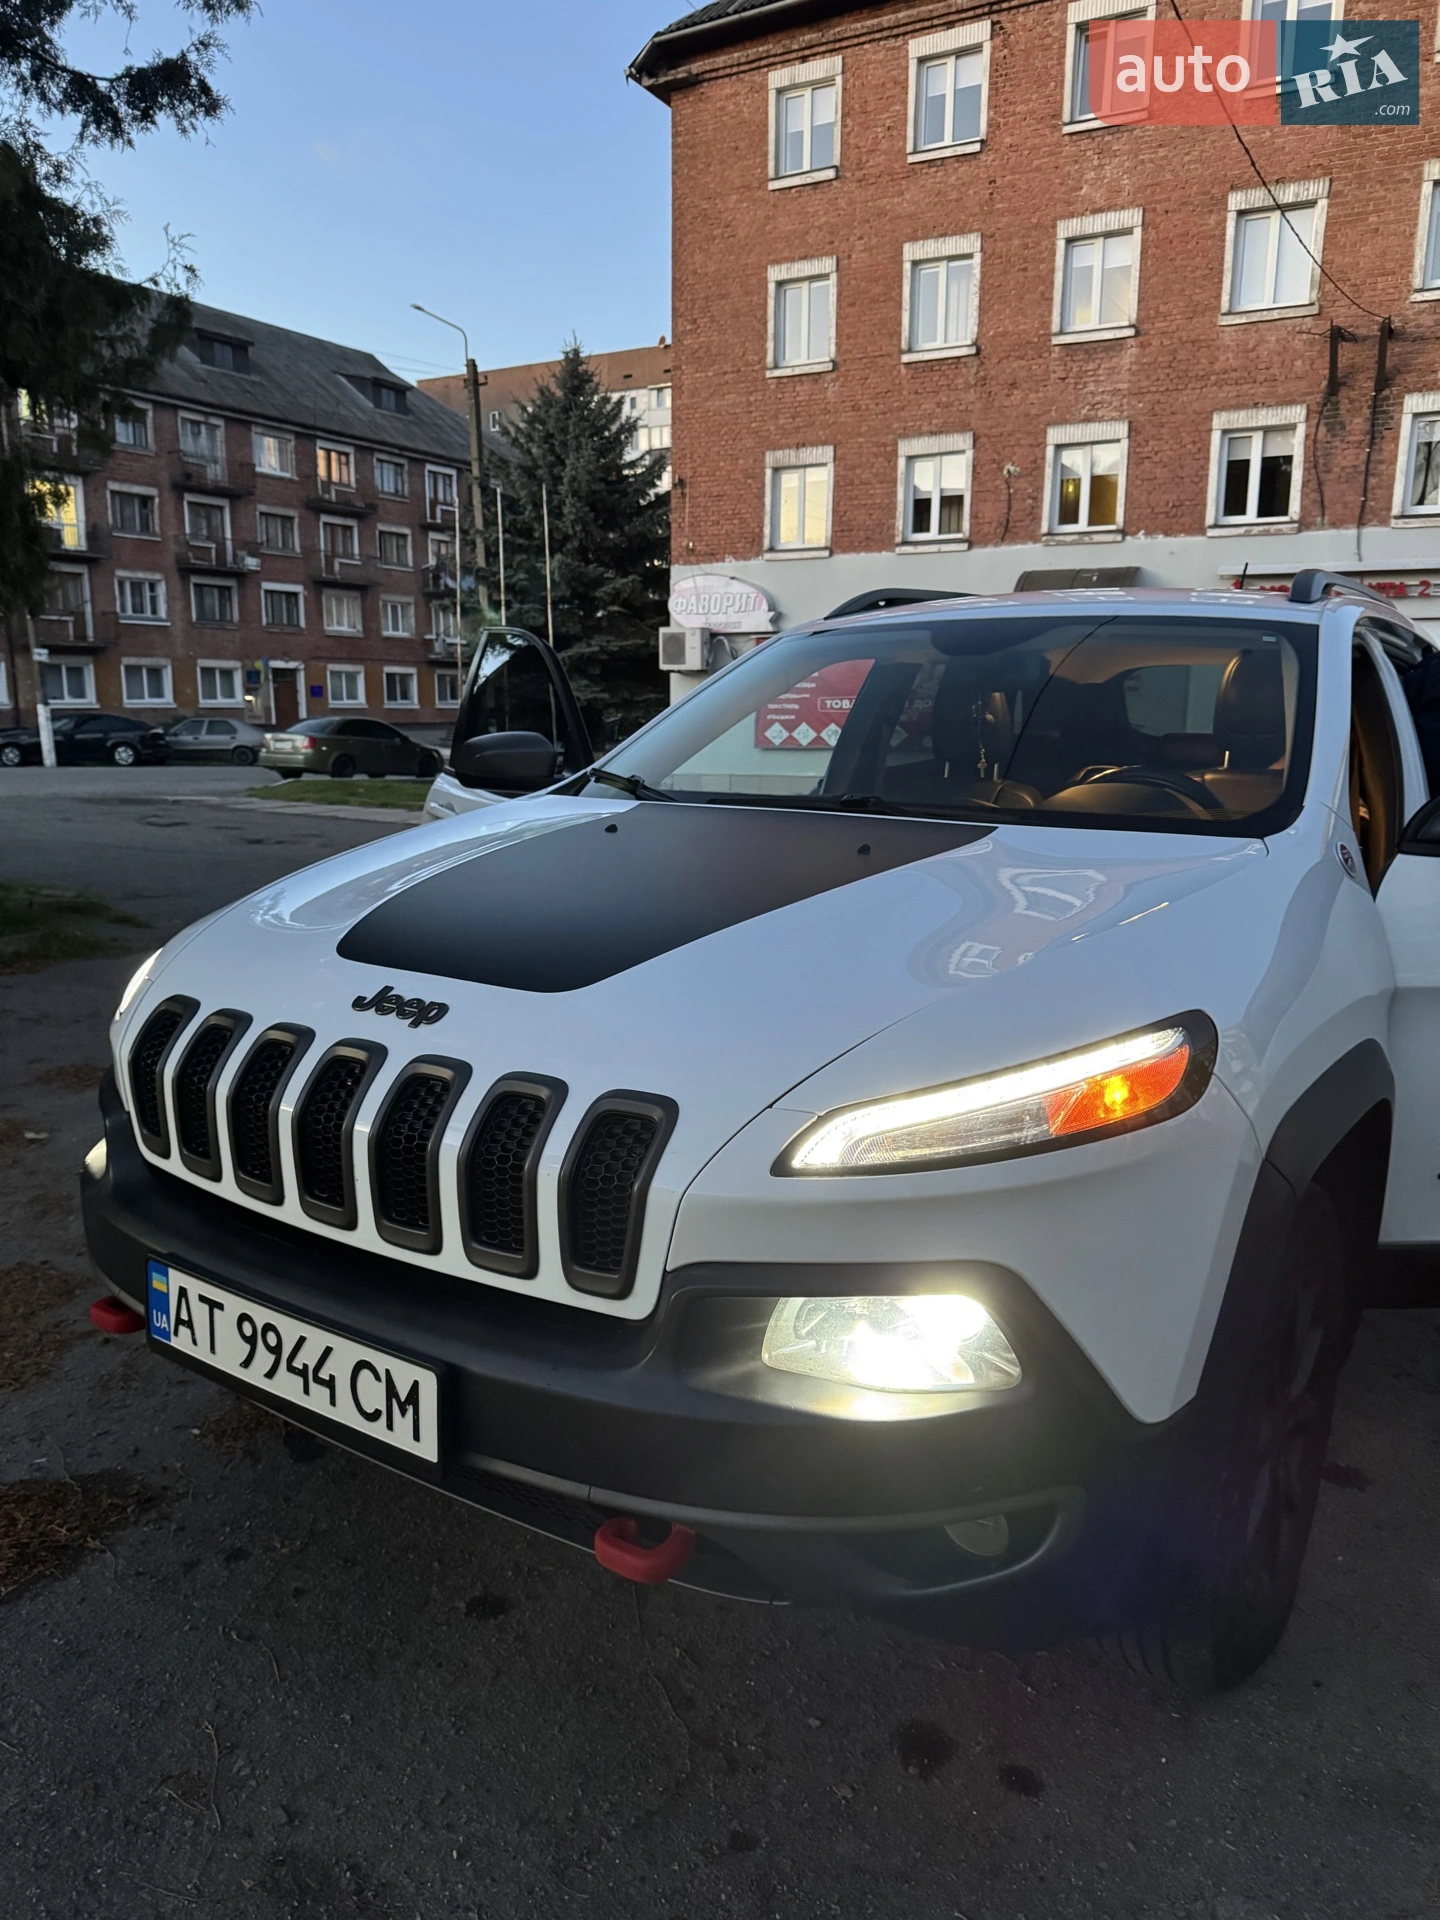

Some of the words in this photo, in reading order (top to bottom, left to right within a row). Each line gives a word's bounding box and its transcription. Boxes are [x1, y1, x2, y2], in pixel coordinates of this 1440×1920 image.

[672, 592, 759, 615] ФАВОРИТ
[825, 698, 855, 710] ТОВ
[351, 985, 450, 1029] Jeep
[152, 1308, 170, 1332] UA
[173, 1284, 225, 1356] AT
[236, 1311, 337, 1408] 9944
[349, 1358, 421, 1443] CM
